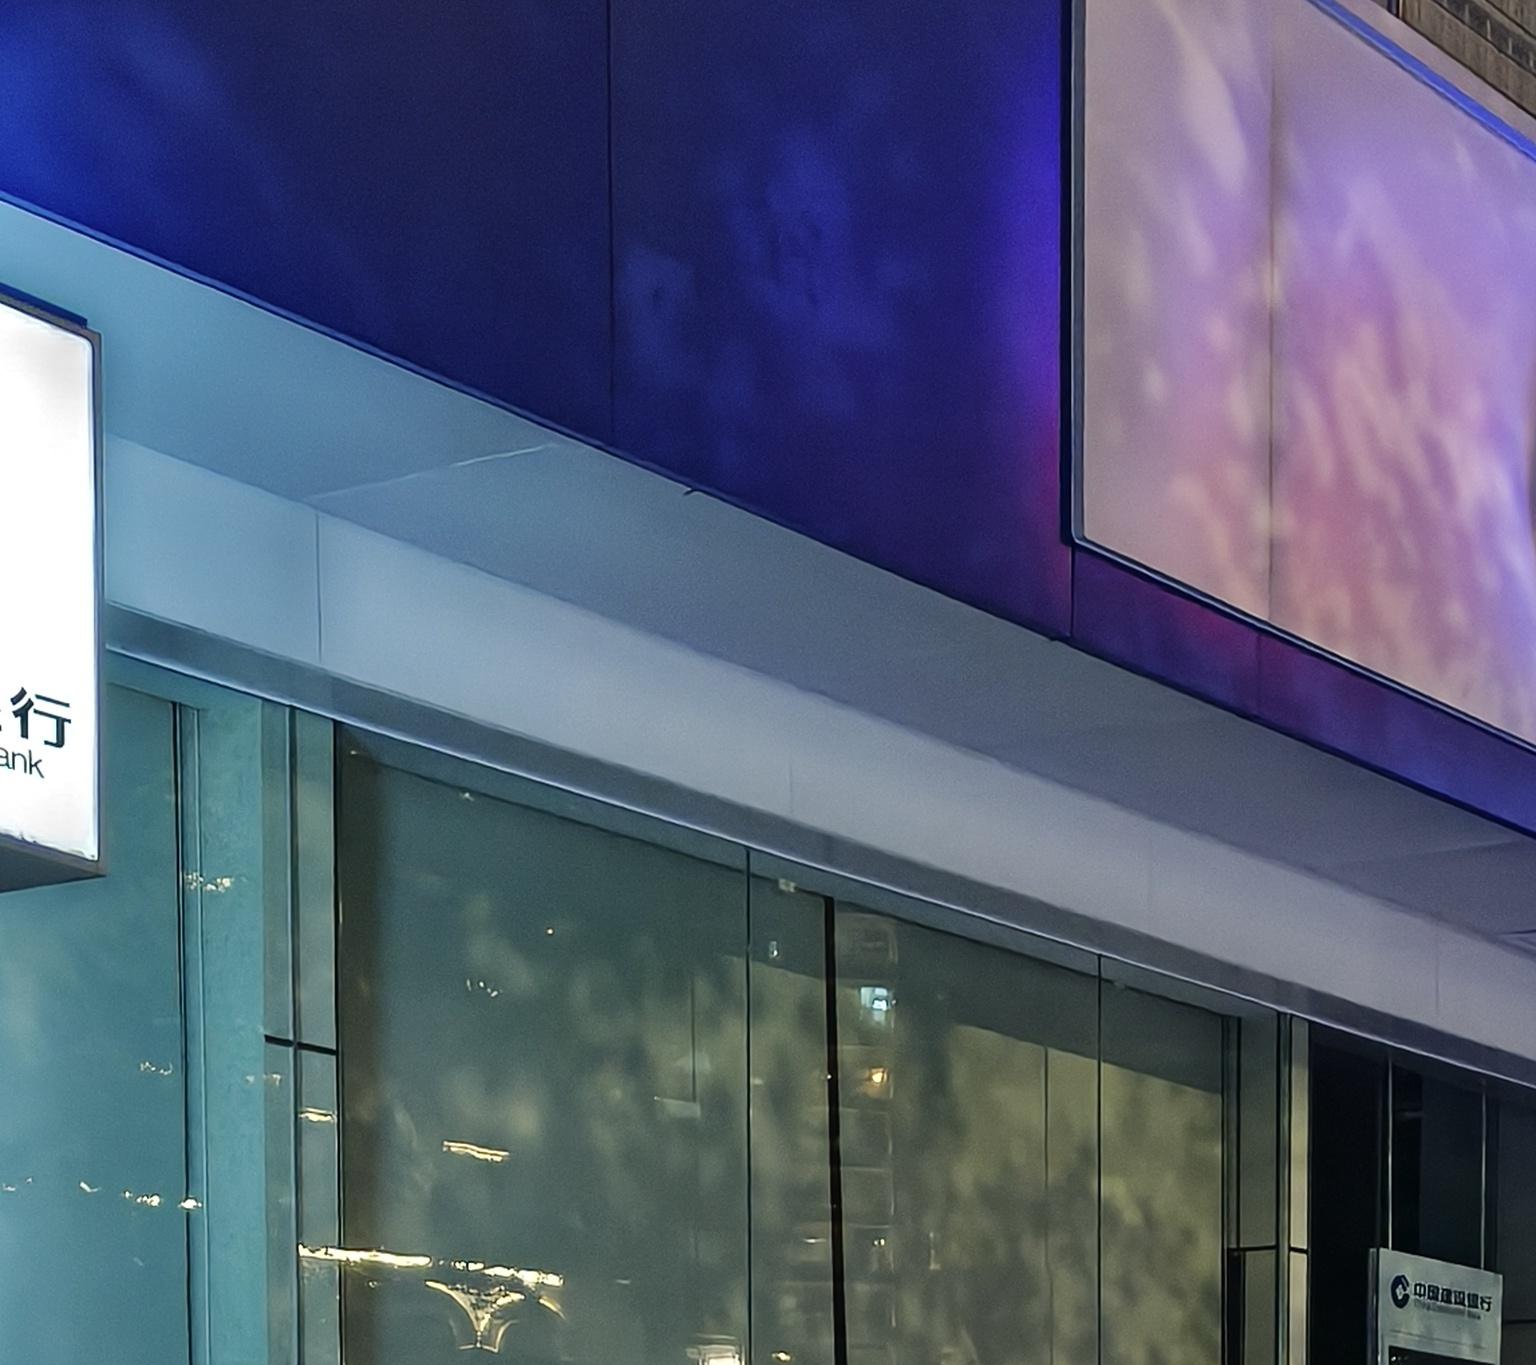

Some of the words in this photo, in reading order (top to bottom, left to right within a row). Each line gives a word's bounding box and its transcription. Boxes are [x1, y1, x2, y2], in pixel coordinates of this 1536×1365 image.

[1413, 1282, 1492, 1312] 中国建设银行
